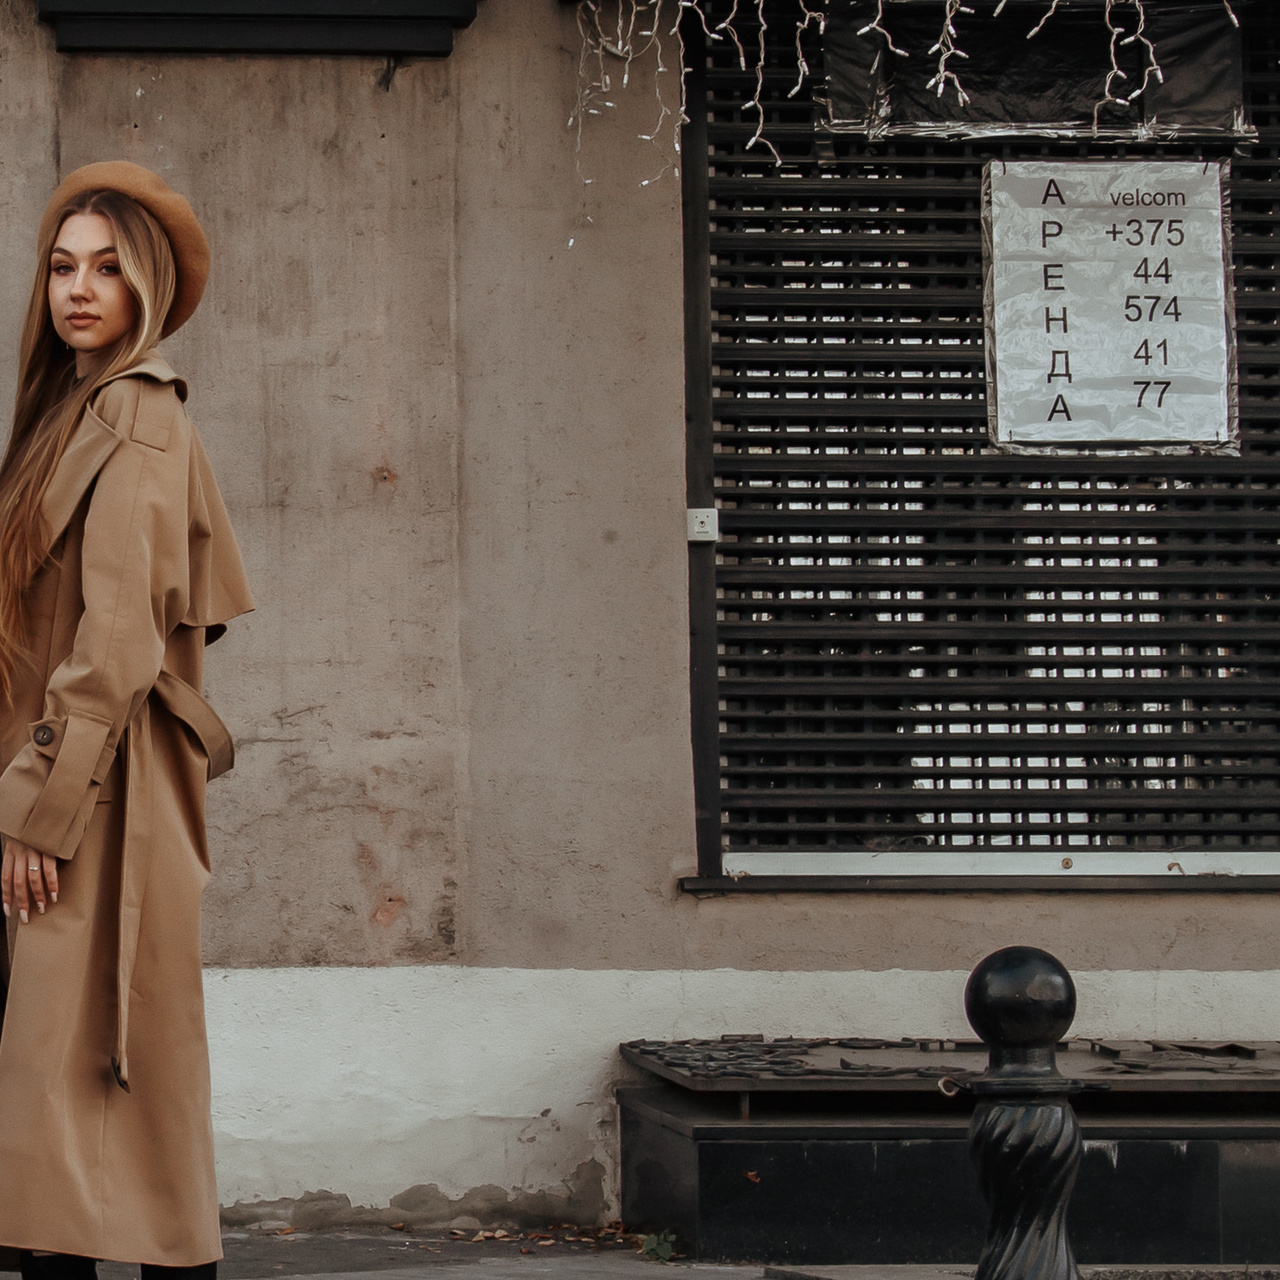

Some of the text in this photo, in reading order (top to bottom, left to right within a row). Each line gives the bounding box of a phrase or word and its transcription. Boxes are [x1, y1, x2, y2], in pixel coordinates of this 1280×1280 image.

[1109, 188, 1186, 207] velcom
[1105, 219, 1185, 247] +375
[1133, 257, 1173, 284] 44
[1040, 178, 1073, 422] АРЕНДА
[1124, 295, 1182, 323] 574
[1133, 338, 1169, 366] 41
[1133, 380, 1172, 408] 77
